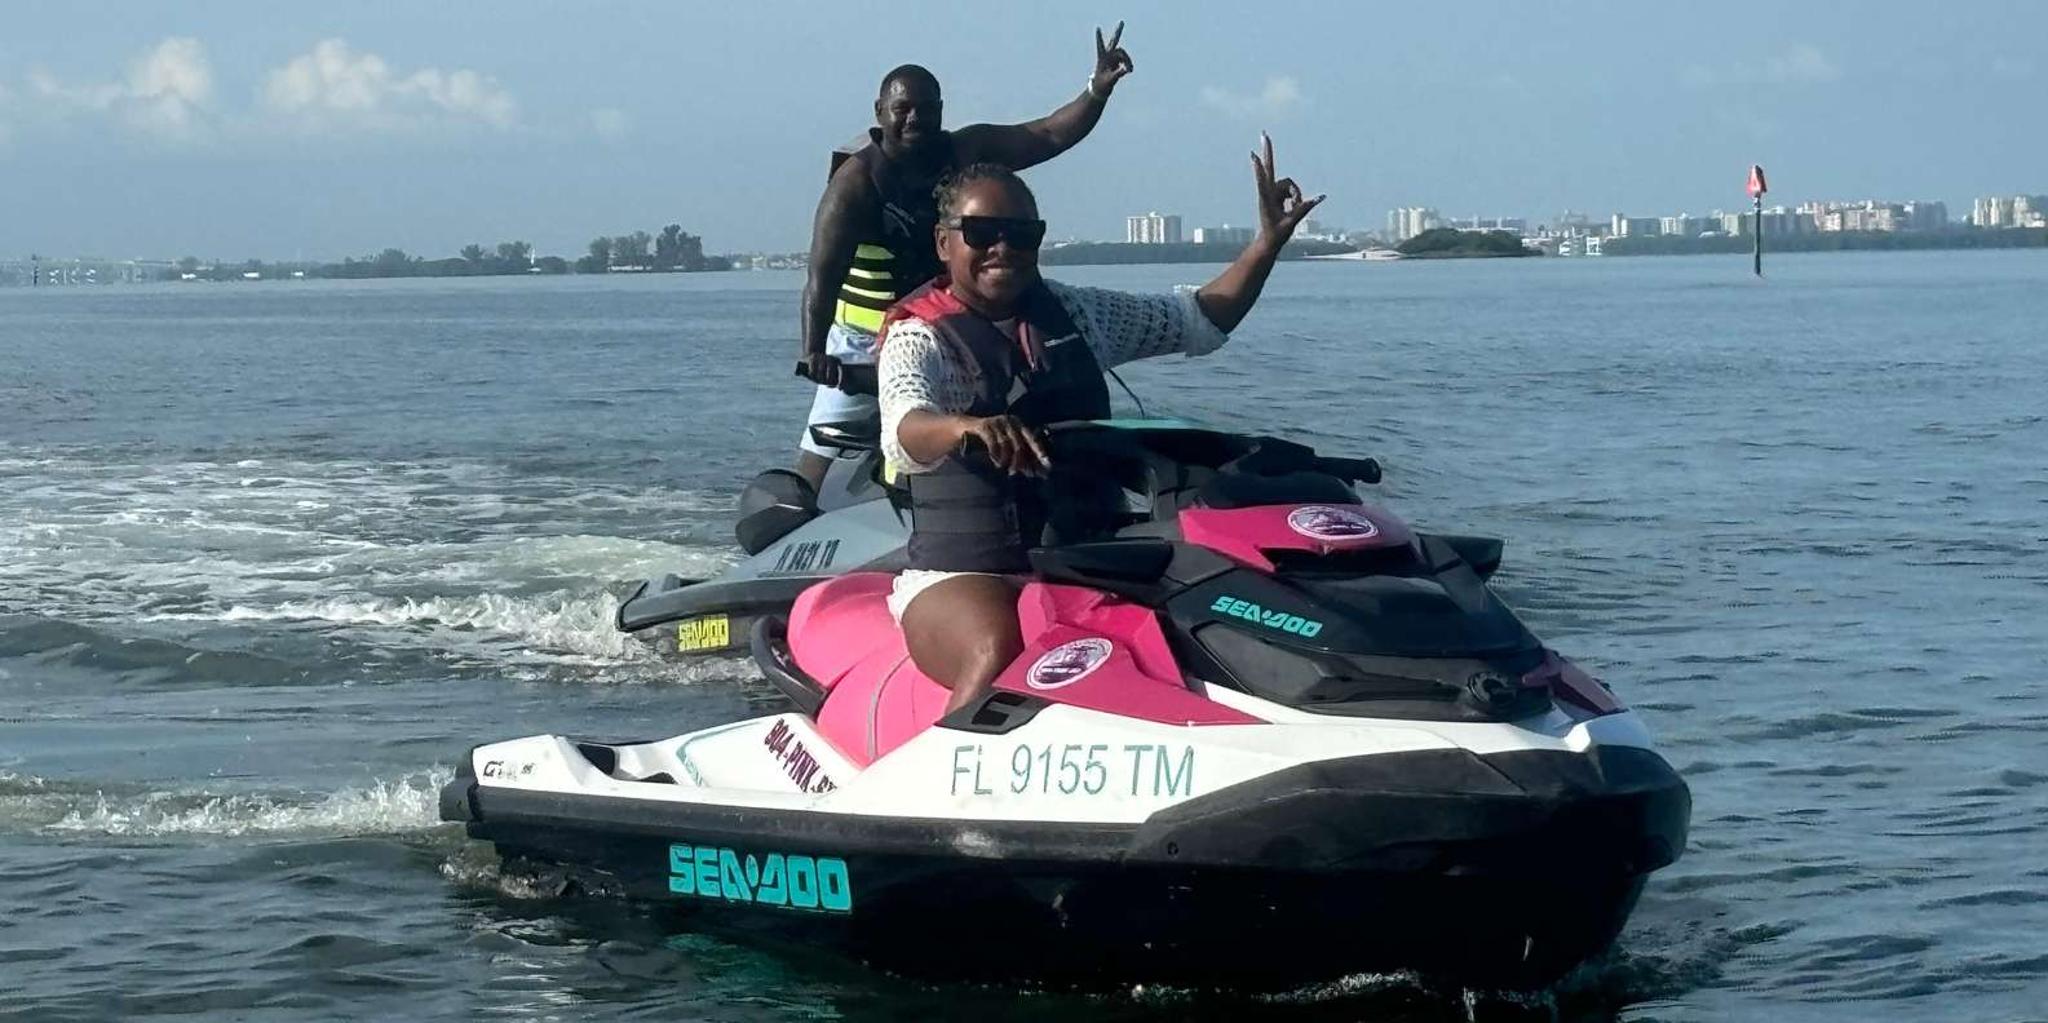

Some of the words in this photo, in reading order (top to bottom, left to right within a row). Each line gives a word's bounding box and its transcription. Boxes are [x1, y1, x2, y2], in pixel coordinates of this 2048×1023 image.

[950, 745, 993, 796] FL
[1010, 743, 1110, 796] 9155
[1123, 745, 1196, 797] TM
